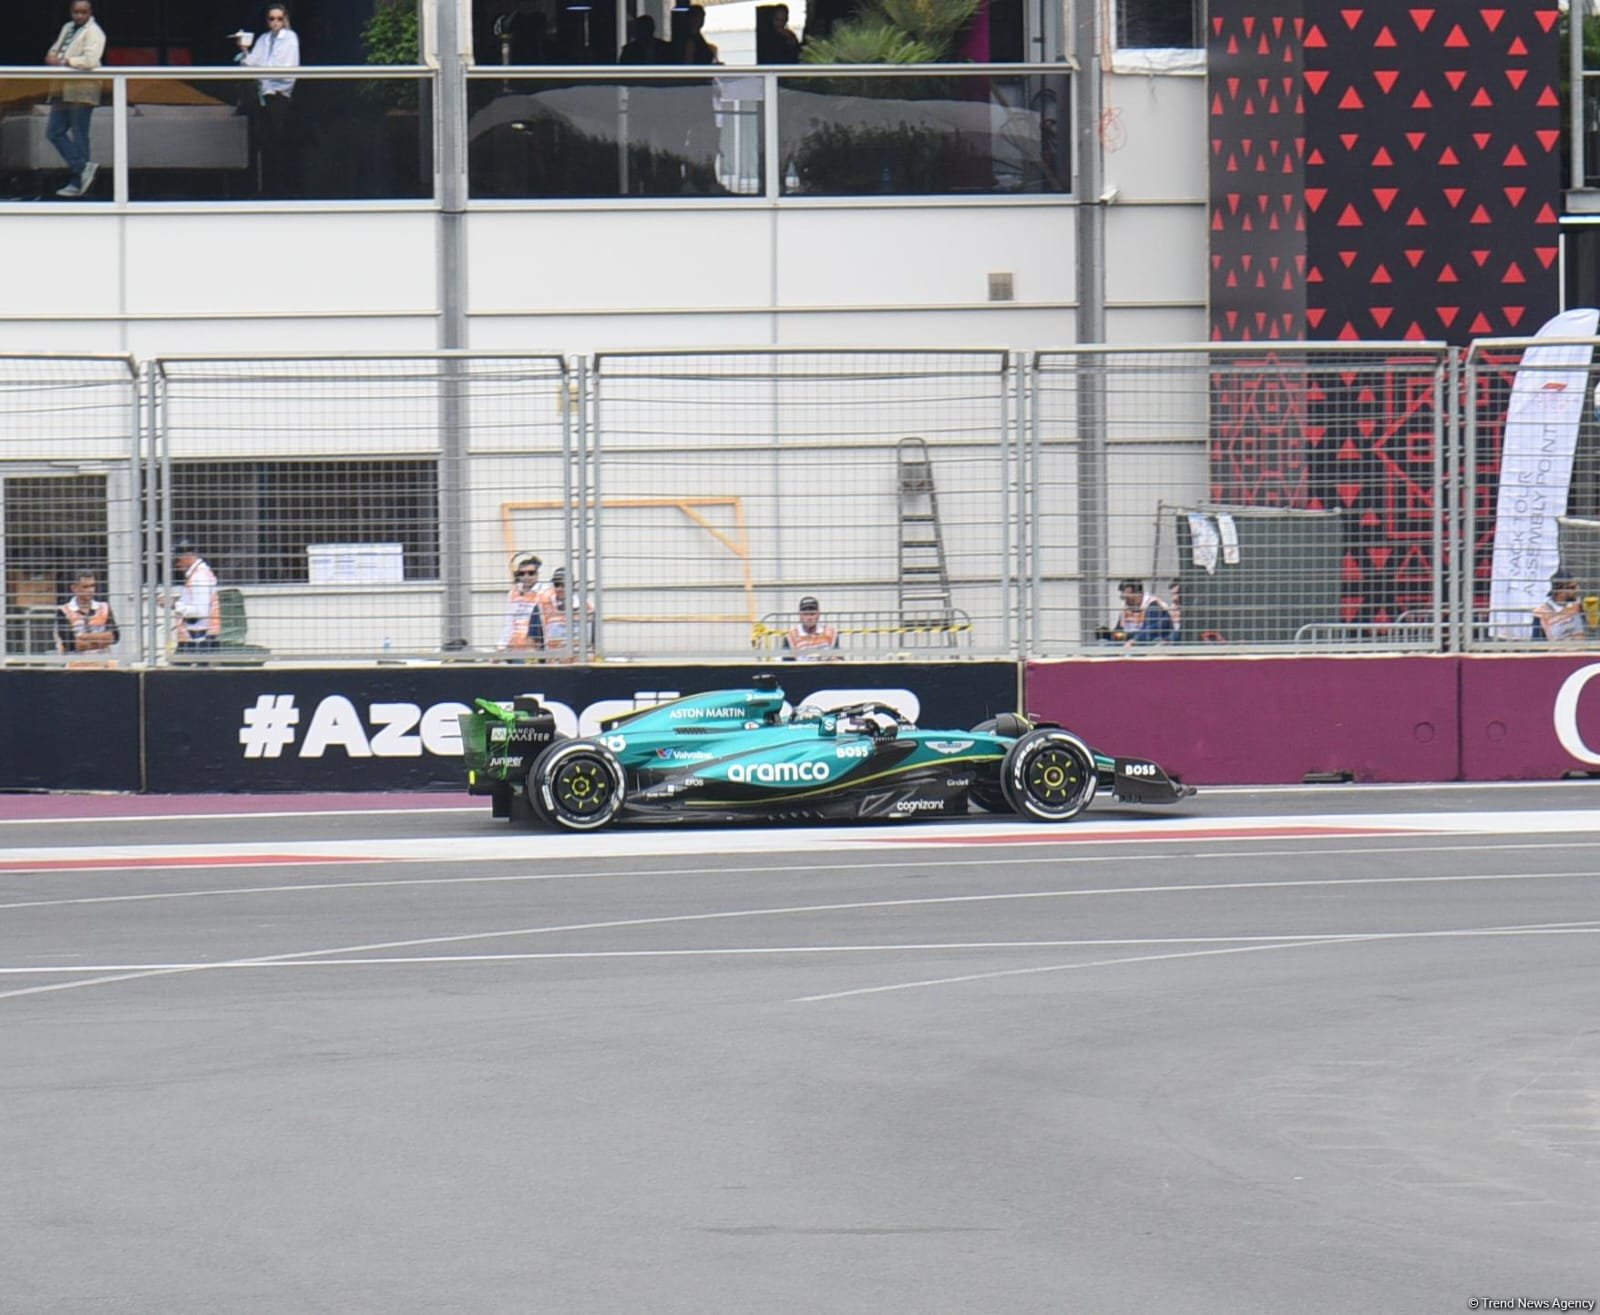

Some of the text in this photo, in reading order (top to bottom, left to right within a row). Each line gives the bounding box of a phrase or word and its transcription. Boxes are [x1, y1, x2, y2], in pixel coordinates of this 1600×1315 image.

[669, 707, 746, 719] ASTON MARTIN
[836, 745, 869, 758] BOSS
[727, 762, 830, 783] aramco
[1125, 764, 1156, 776] BOSS
[896, 798, 945, 813] cognizant
